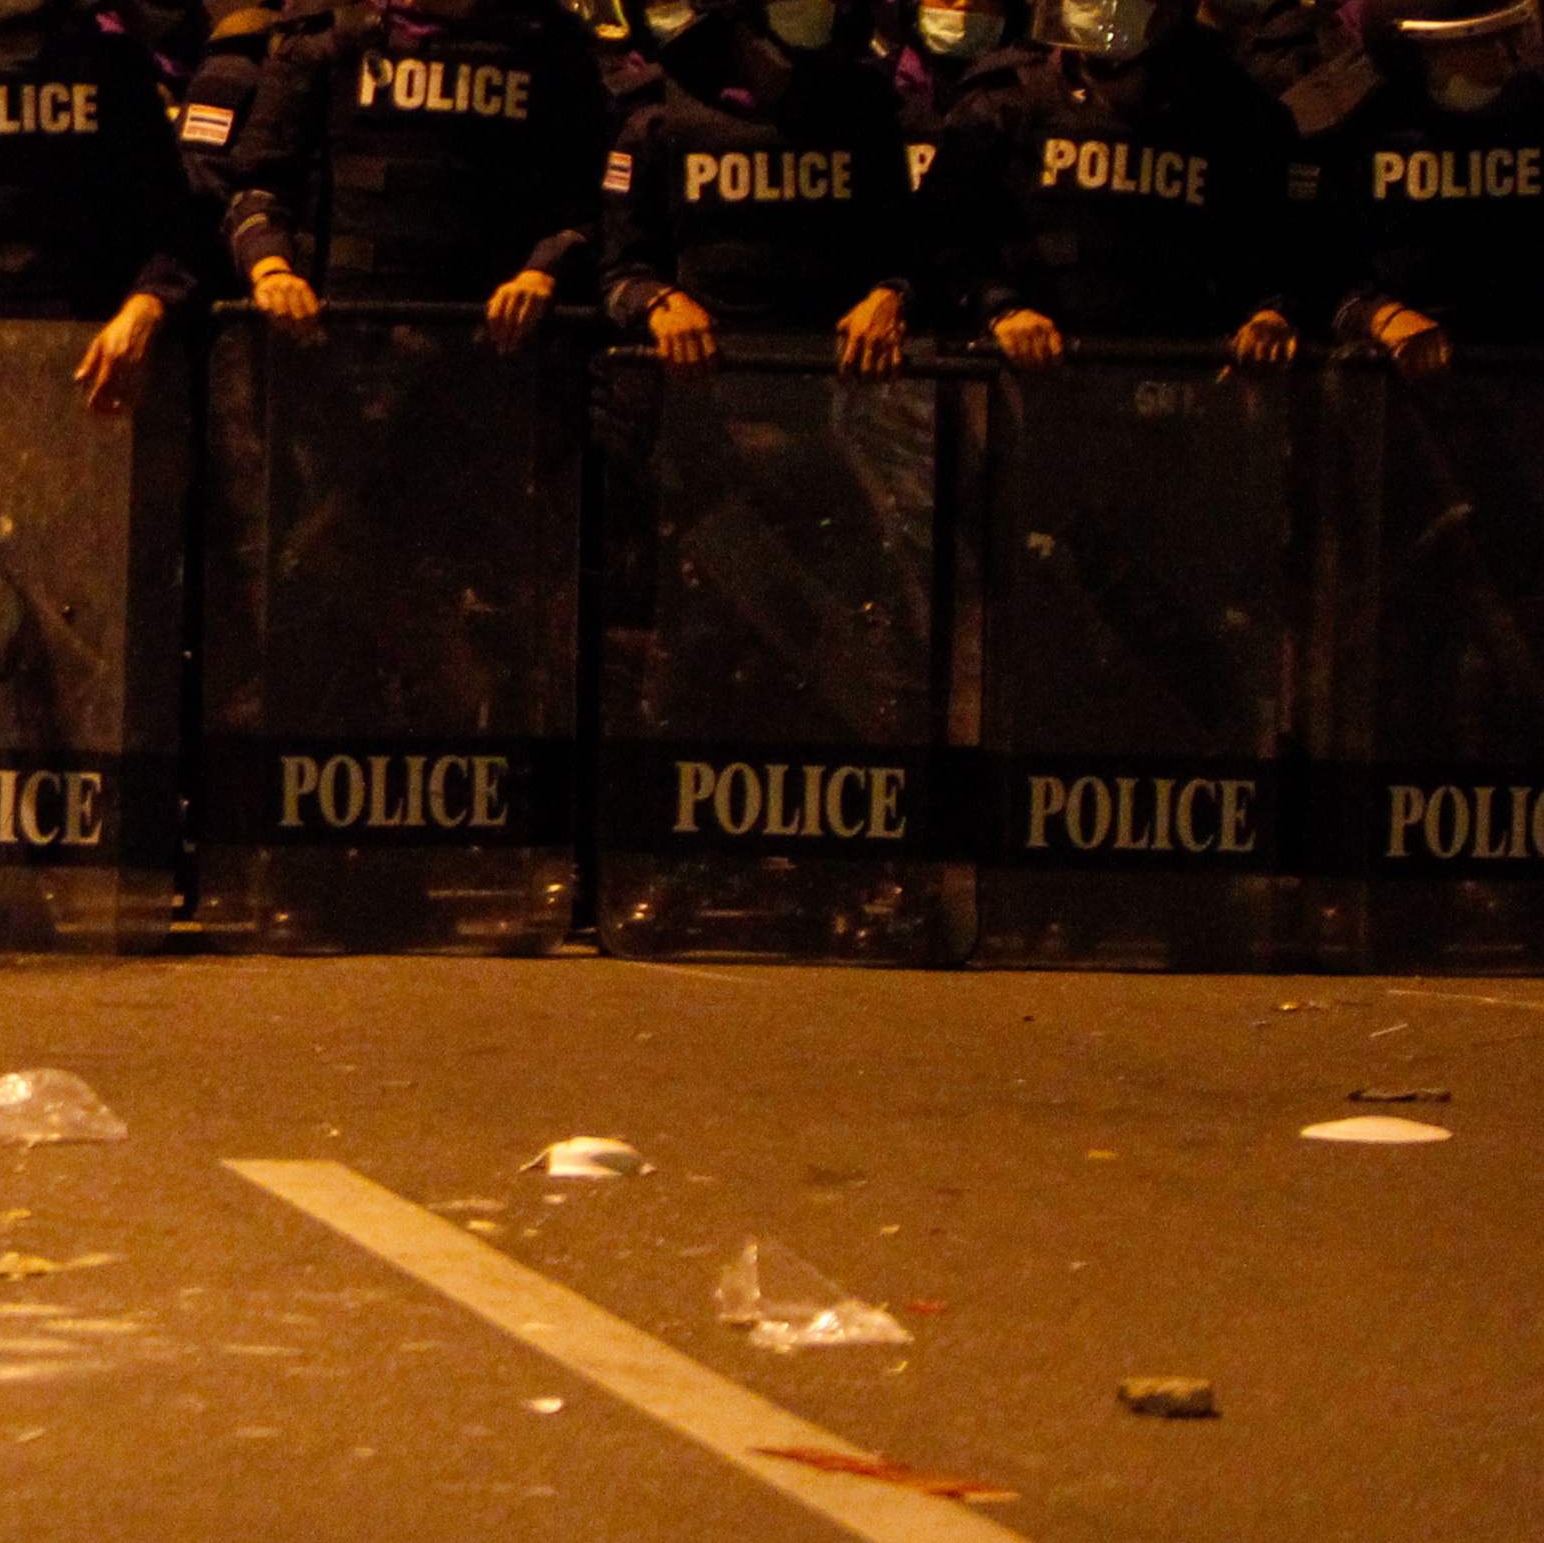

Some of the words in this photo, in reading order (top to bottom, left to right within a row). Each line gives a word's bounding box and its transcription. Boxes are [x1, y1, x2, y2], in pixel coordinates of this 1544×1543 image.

[359, 58, 530, 120] POLICE
[686, 151, 852, 201] POLICE
[1041, 139, 1208, 206] POLICE
[1375, 148, 1541, 199] POLICE
[282, 755, 505, 827] POLICE
[674, 762, 904, 838] POLICE
[1028, 777, 1254, 851] POLICE
